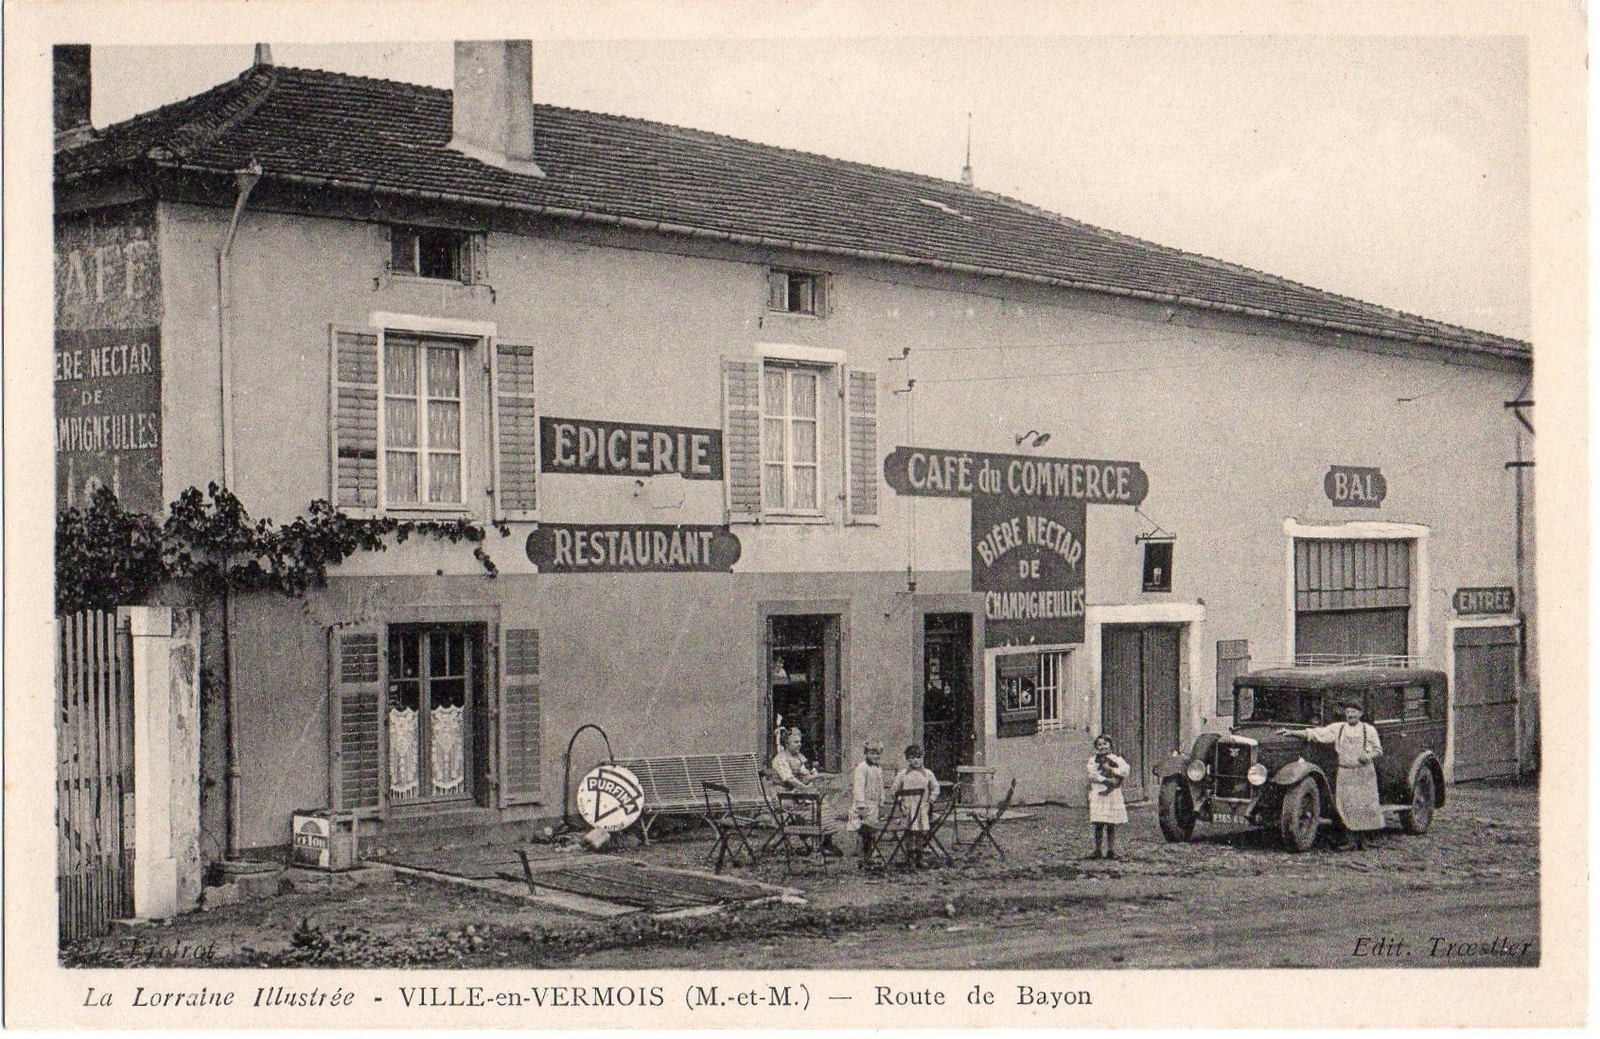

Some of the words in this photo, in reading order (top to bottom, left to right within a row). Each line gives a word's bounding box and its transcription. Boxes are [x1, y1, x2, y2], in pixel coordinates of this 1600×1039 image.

[91, 343, 152, 378] NECTAR
[81, 390, 103, 406] DE
[553, 423, 712, 474] EPICERIE
[908, 452, 973, 492] CAFÉ
[978, 458, 1001, 494] du
[1007, 461, 1131, 498] COMMERCE
[1334, 472, 1379, 500] BAL
[553, 529, 713, 567] RESTAURANT
[1026, 516, 1083, 571] NECTAR
[1019, 560, 1041, 579] DE
[985, 588, 1085, 619] CHAMPIGNEULLES
[588, 778, 636, 814] PURFINA
